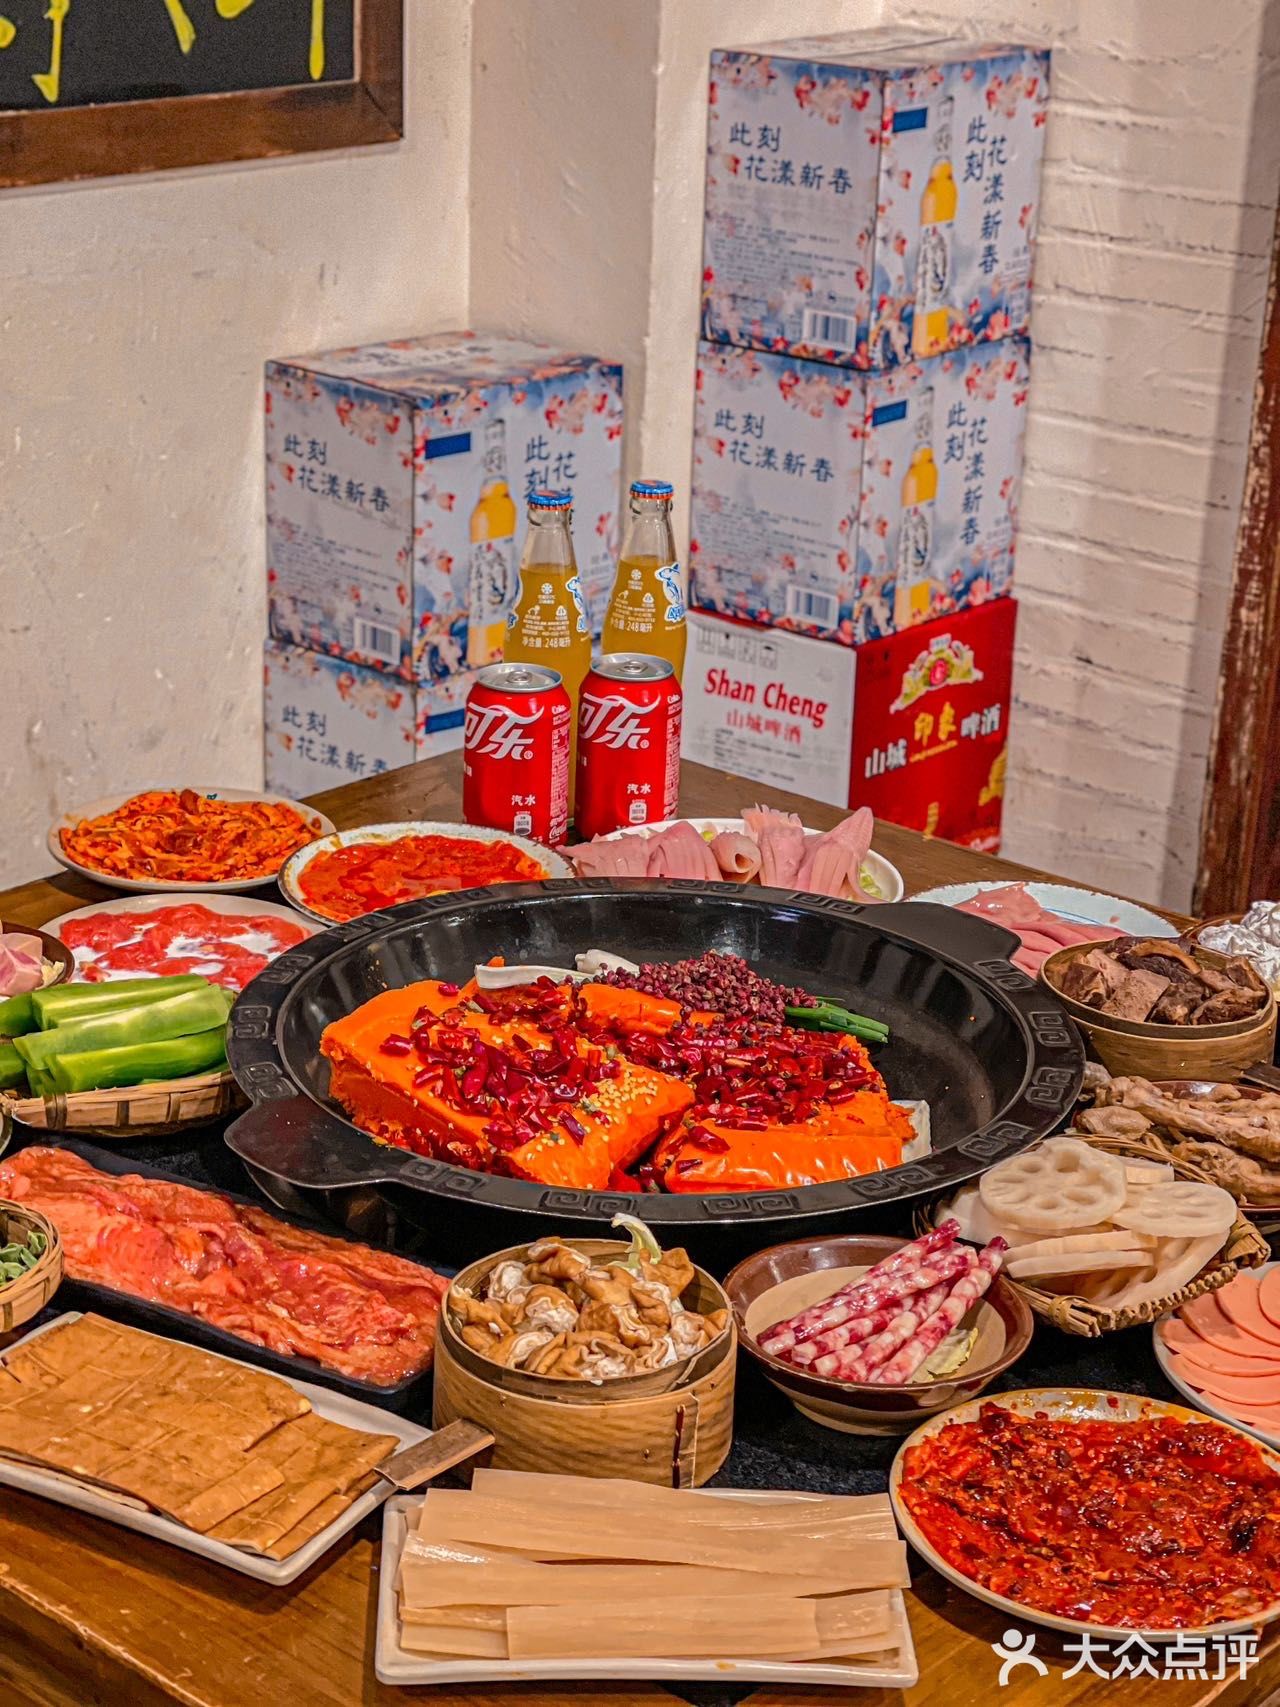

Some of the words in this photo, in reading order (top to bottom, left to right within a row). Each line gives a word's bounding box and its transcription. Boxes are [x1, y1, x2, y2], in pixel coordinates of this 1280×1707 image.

[729, 121, 781, 152] 此刻
[962, 115, 988, 183] 此刻
[744, 155, 853, 195] 花漾新春
[978, 136, 1008, 274] 花漾新春
[713, 408, 765, 440] 此刻
[944, 402, 969, 465] 此刻
[282, 433, 327, 467] 此刻
[728, 440, 835, 483] 花漾新春
[297, 465, 391, 513] 花漾新春
[960, 416, 988, 546] 花漾新春
[704, 667, 756, 705] Shan
[763, 682, 828, 729] Cheng
[281, 705, 327, 737] 此刻
[511, 794, 537, 807] 汽水
[626, 783, 652, 795] 汽水
